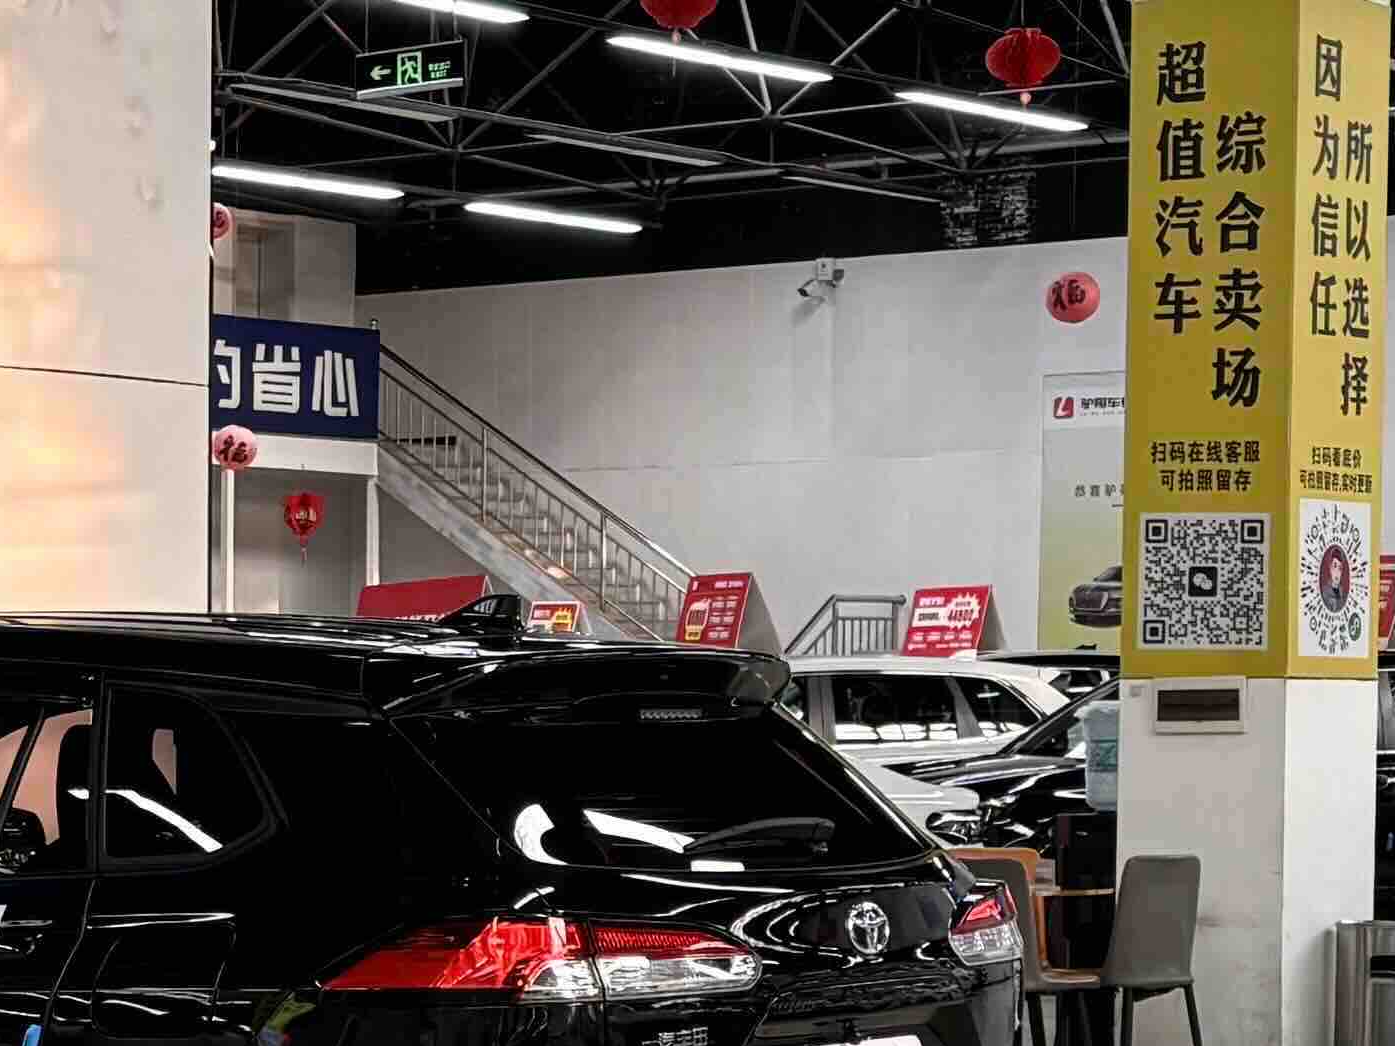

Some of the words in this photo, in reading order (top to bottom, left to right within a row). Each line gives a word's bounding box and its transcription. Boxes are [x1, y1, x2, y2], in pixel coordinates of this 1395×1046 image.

[1154, 40, 1207, 336] 超值汽车
[1211, 111, 1267, 408] 综合卖场
[1309, 34, 1343, 338] 因为信任
[1340, 119, 1373, 416] 所以选择
[1150, 440, 1261, 464] 扫码在线客服
[1159, 467, 1252, 492] 可拍照留存
